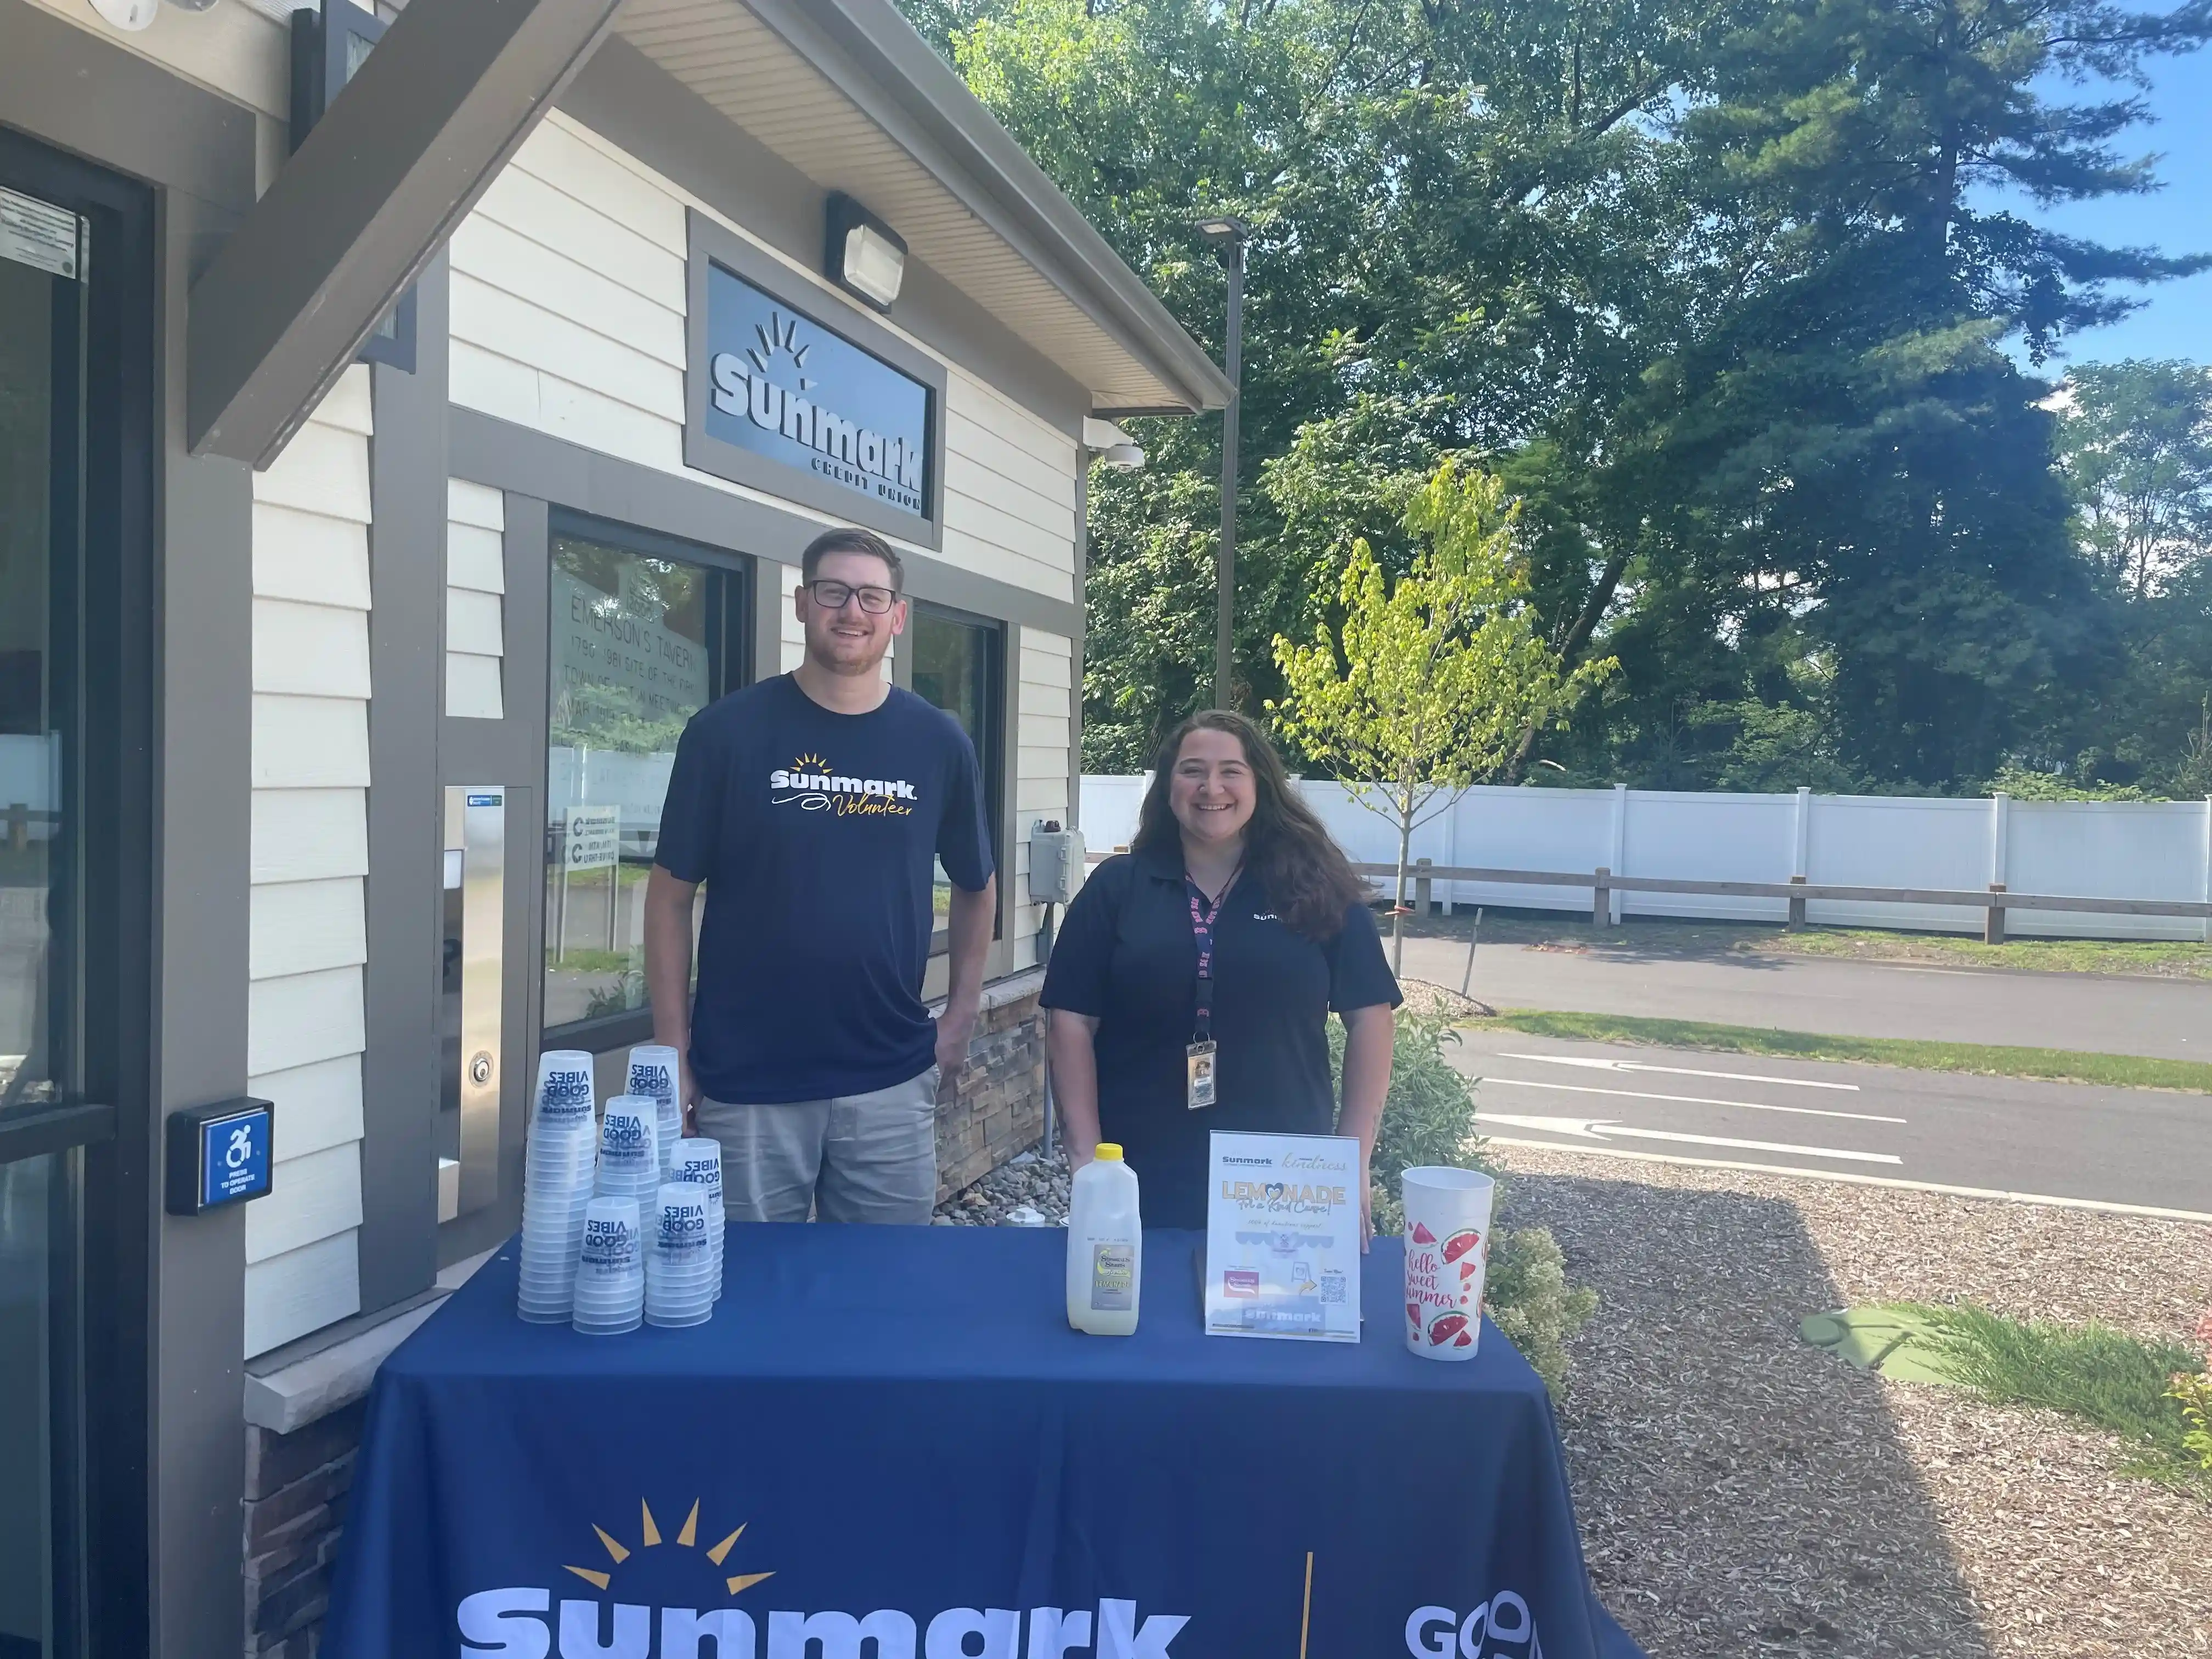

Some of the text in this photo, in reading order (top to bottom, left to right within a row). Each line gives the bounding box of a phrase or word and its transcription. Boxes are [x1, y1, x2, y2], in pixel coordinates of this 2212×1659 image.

[710, 352, 923, 492] Sunmark
[811, 457, 921, 510] CREDIT UNION
[571, 595, 651, 653] EMERSON'S
[648, 666, 658, 681] OF
[832, 789, 912, 816] Volunteer
[549, 1070, 589, 1083] VIBES
[631, 1064, 668, 1076] VIBES
[548, 1084, 589, 1097] GOOD
[630, 1077, 669, 1090] GOOD
[605, 1114, 641, 1128] VIBES
[603, 1127, 642, 1141] GOOD
[685, 1158, 719, 1172] VIBES
[1222, 1156, 1273, 1165] Sunmark
[221, 1181, 229, 1189] TO
[664, 1205, 703, 1218] VIBES
[587, 1220, 627, 1234] VIBES
[662, 1218, 704, 1232] GOOD
[585, 1234, 628, 1248] GOOD
[1408, 1249, 1441, 1273] hello
[1407, 1270, 1439, 1291] sweet
[456, 1587, 1192, 1659] Sunmark
